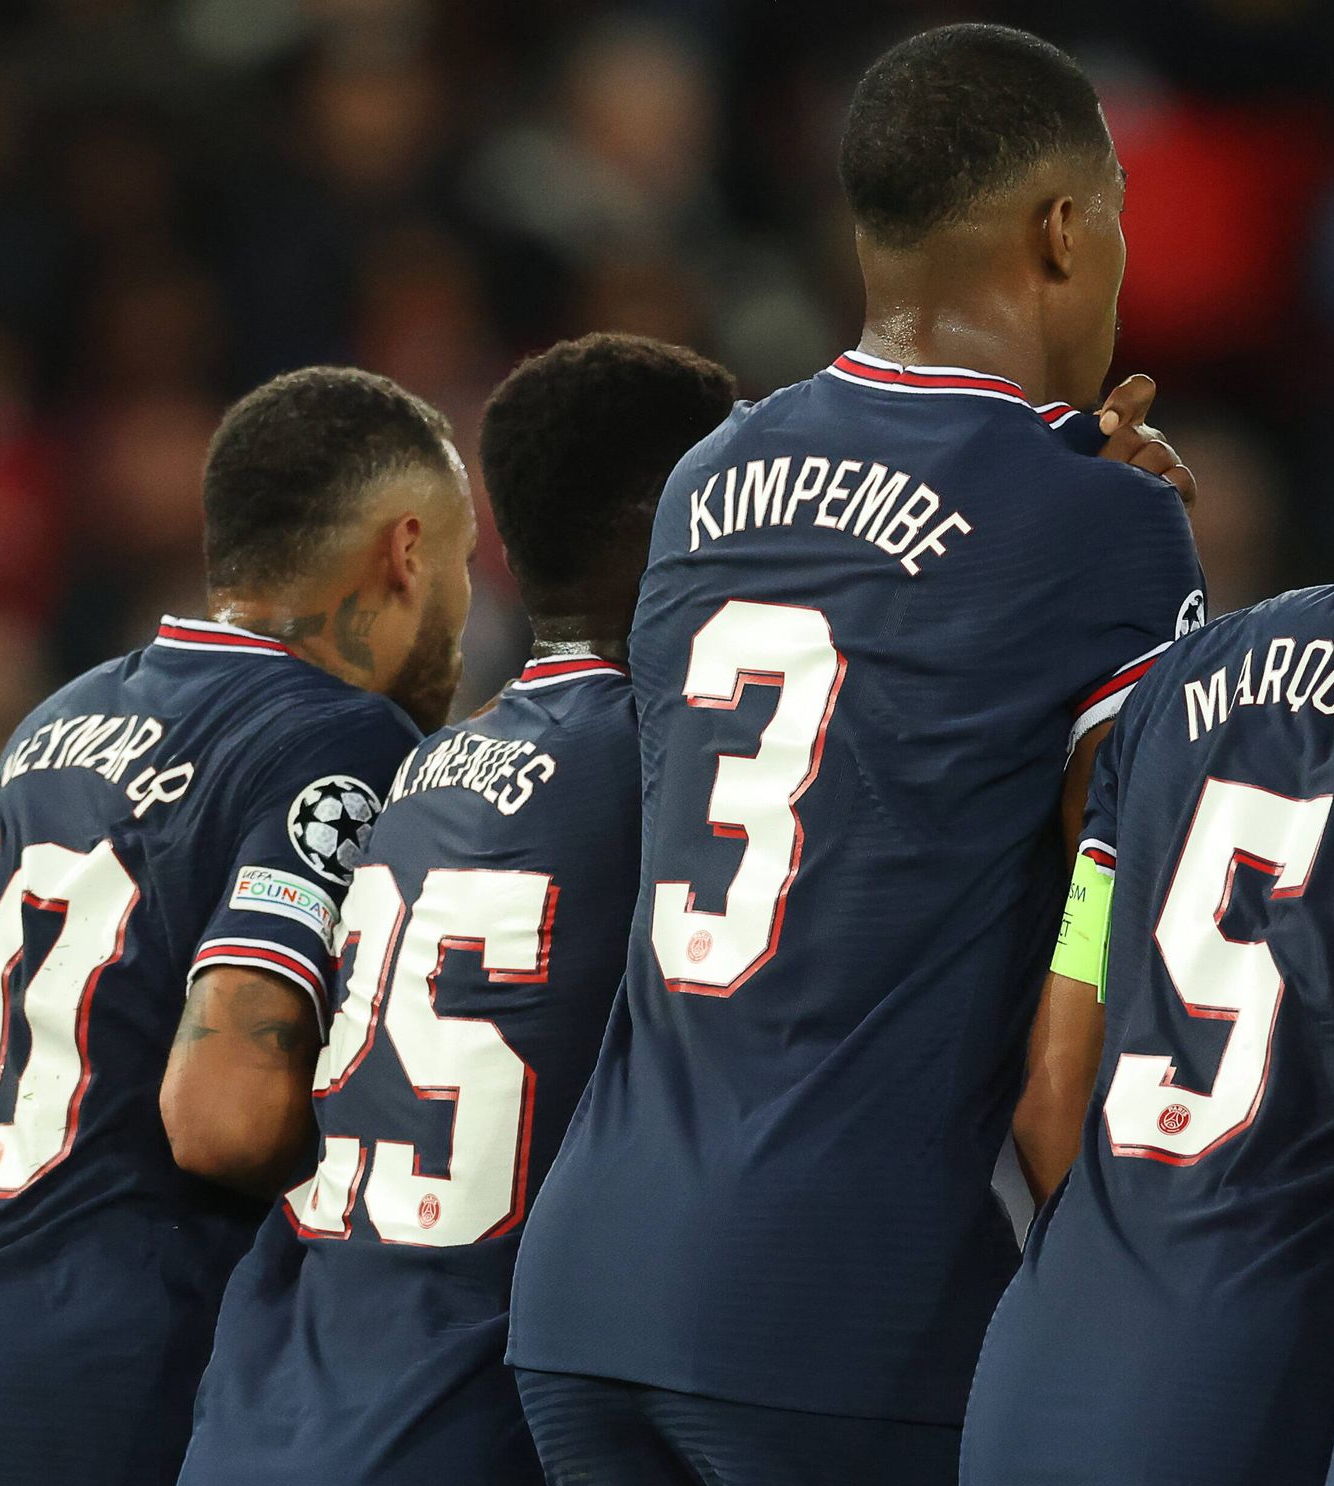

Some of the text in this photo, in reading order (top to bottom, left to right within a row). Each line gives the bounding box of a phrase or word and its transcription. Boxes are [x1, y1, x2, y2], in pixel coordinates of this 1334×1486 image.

[688, 455, 973, 576] KIMPEMBE
[125, 761, 195, 819] JR
[651, 598, 848, 998] 3
[242, 870, 273, 881] UEFA
[1103, 776, 1334, 1167] 5
